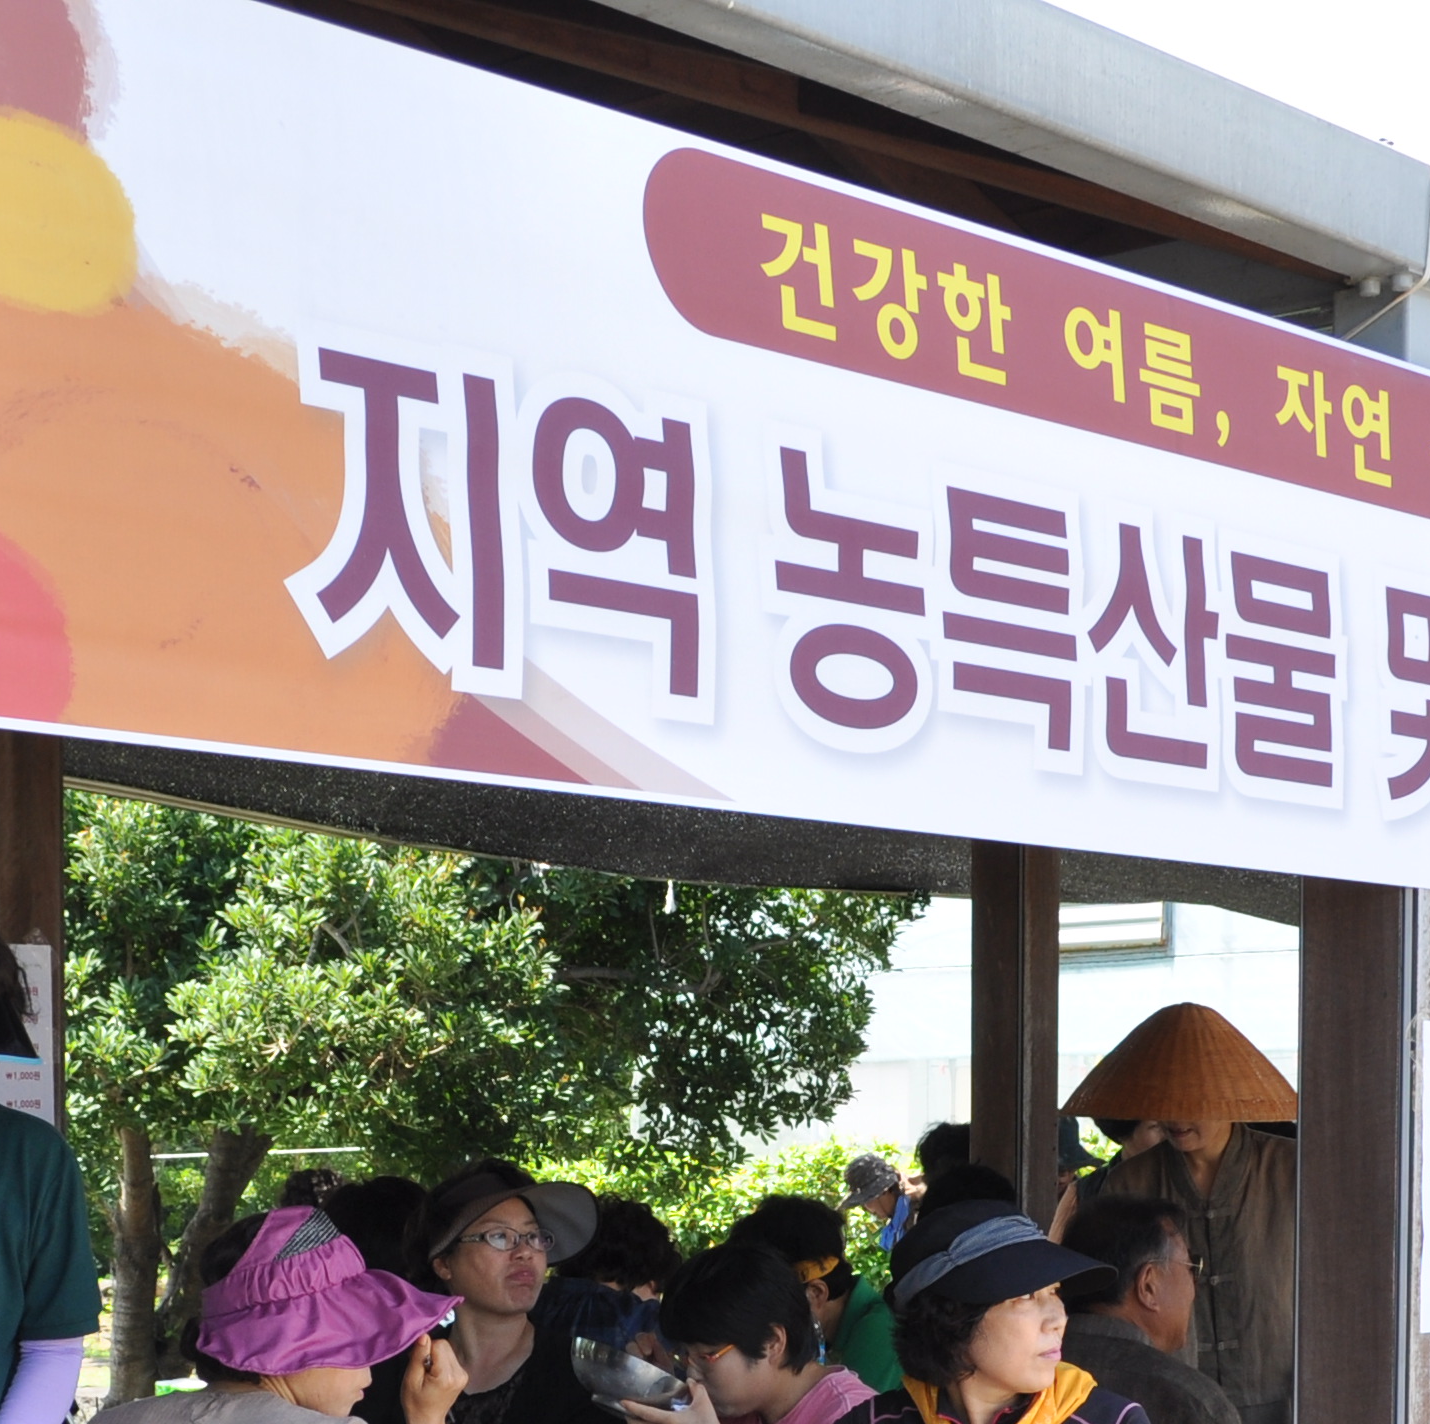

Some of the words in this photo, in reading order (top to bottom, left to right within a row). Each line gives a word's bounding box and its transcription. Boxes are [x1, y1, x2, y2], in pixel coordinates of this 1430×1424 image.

[760, 210, 1012, 387] 건강한
[1062, 305, 1232, 448] 여름,
[1275, 362, 1393, 491] 자연
[316, 346, 701, 699] 지역
[773, 444, 1339, 790] 농특산물
